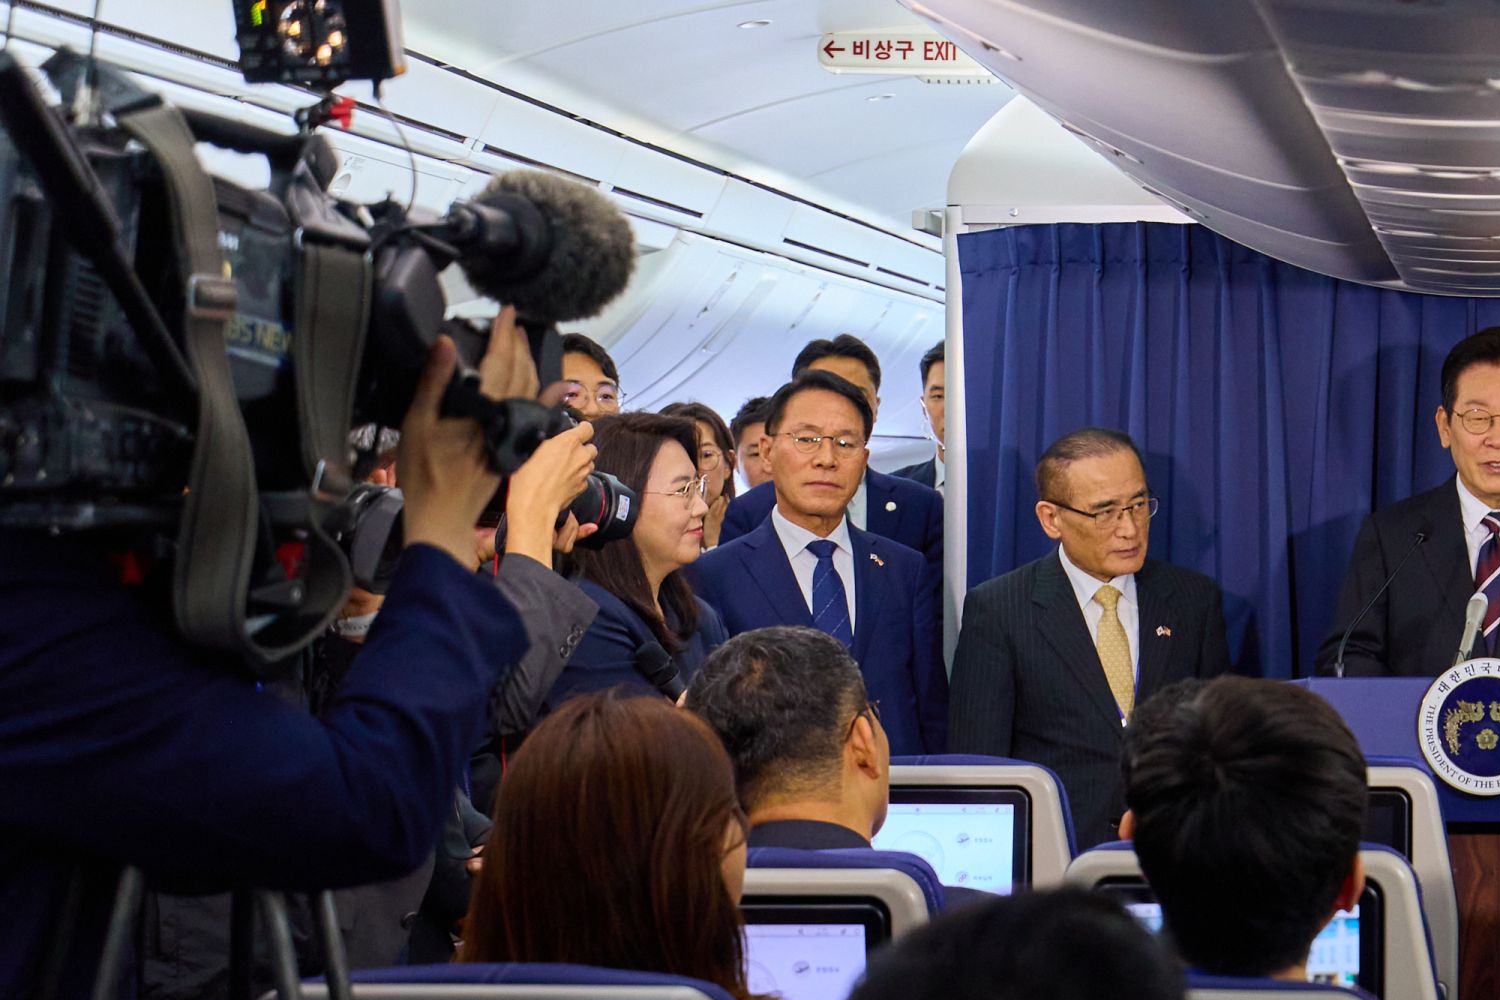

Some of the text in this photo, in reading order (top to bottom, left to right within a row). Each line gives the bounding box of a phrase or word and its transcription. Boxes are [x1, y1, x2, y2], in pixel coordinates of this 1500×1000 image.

[852, 40, 957, 61] 비상구 EXIT
[1425, 704, 1437, 727] THE
[1426, 728, 1459, 779] PRESIDENT
[1457, 774, 1473, 787] OF
[1473, 779, 1495, 789] THE
